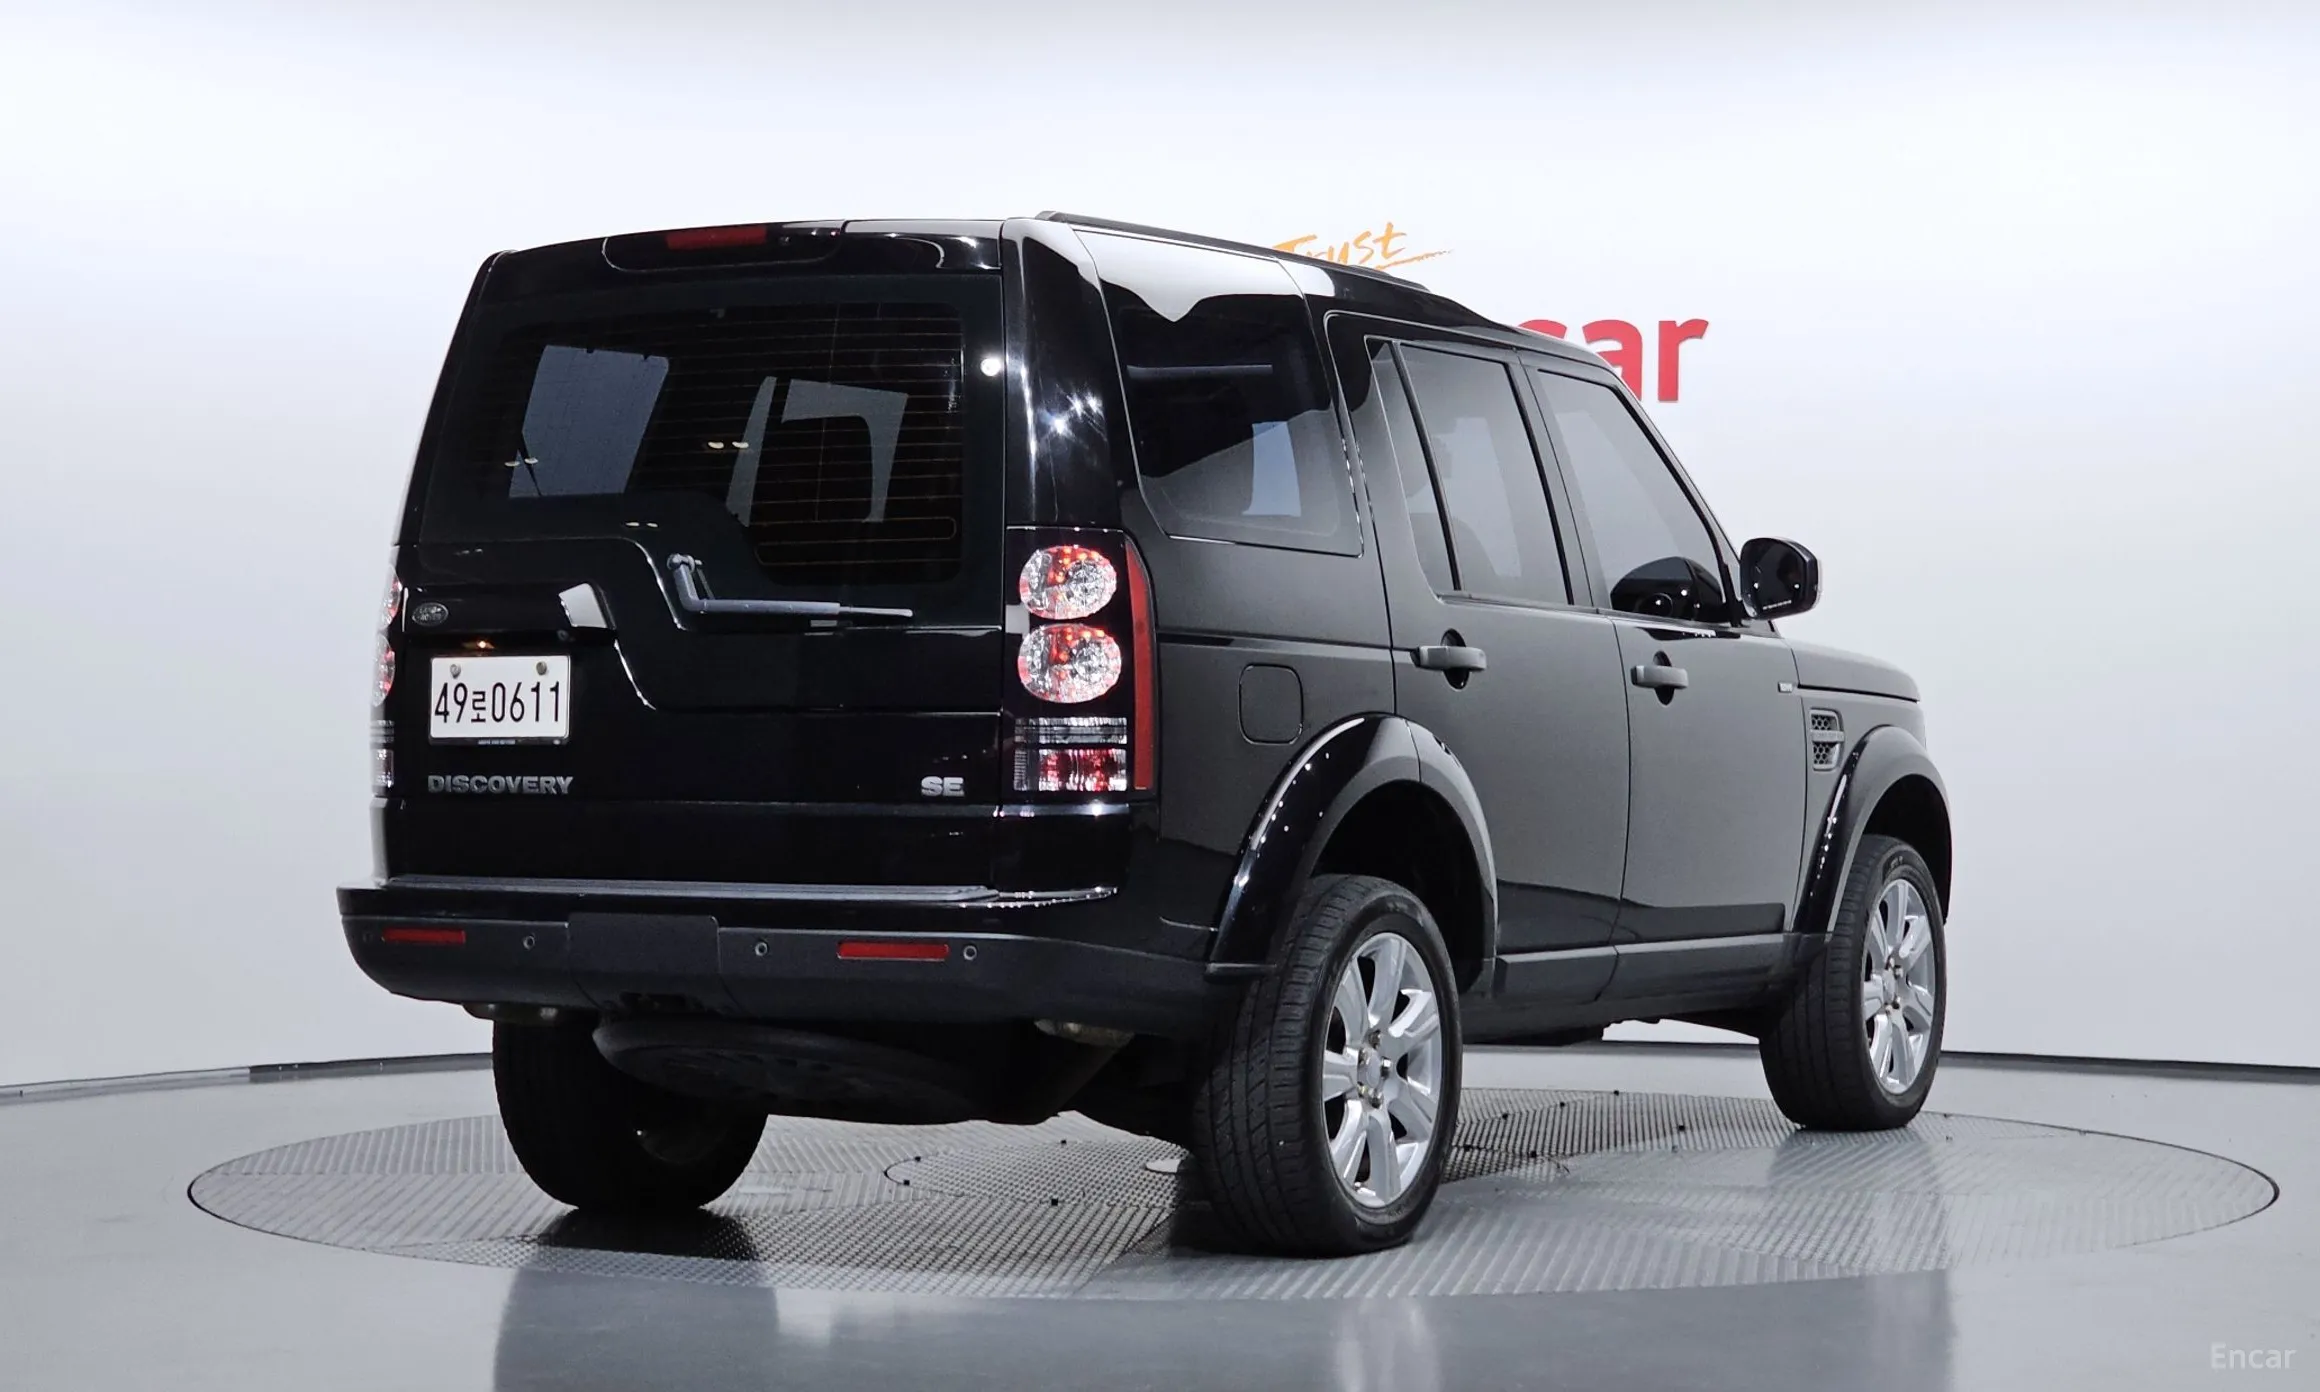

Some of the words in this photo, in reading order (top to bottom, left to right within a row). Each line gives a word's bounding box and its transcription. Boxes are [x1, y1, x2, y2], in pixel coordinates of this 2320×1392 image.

[1518, 319, 1709, 402] ar
[434, 681, 560, 723] 49로0611
[427, 774, 573, 795] DISCOVERY
[921, 776, 965, 797] SE
